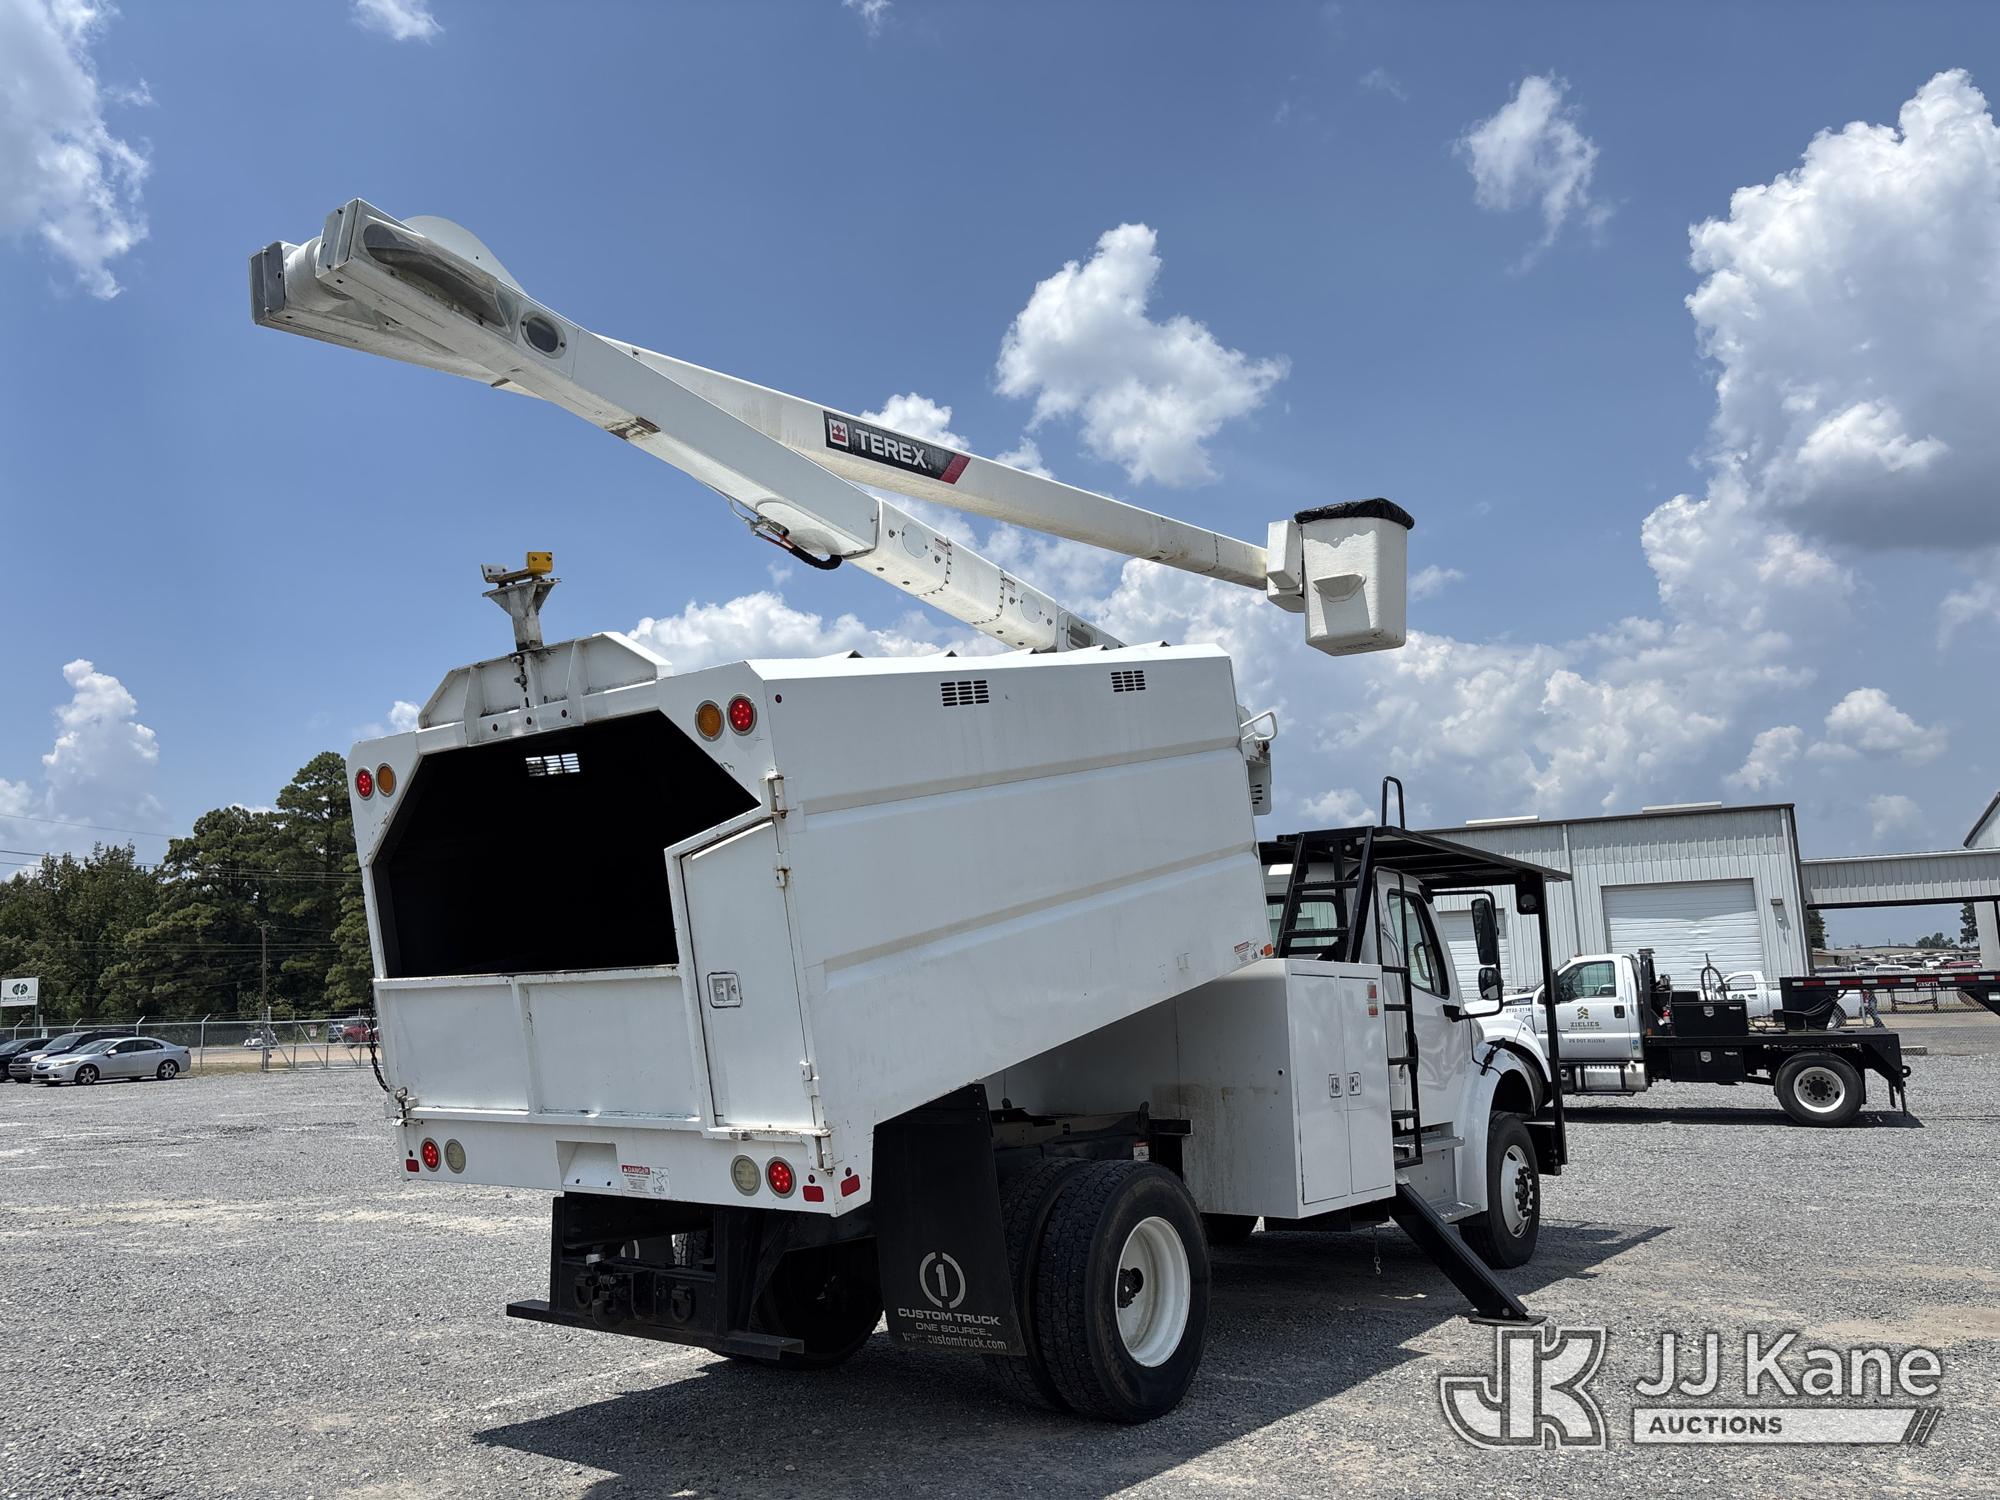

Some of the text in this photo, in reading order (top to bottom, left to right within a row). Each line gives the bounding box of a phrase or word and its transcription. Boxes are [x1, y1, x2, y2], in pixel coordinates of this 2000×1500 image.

[855, 429, 927, 469] TEREX
[628, 1166, 649, 1174] DANGER
[897, 1308, 1002, 1326] CUSTOM TRUCK
[915, 1322, 939, 1332] ONE
